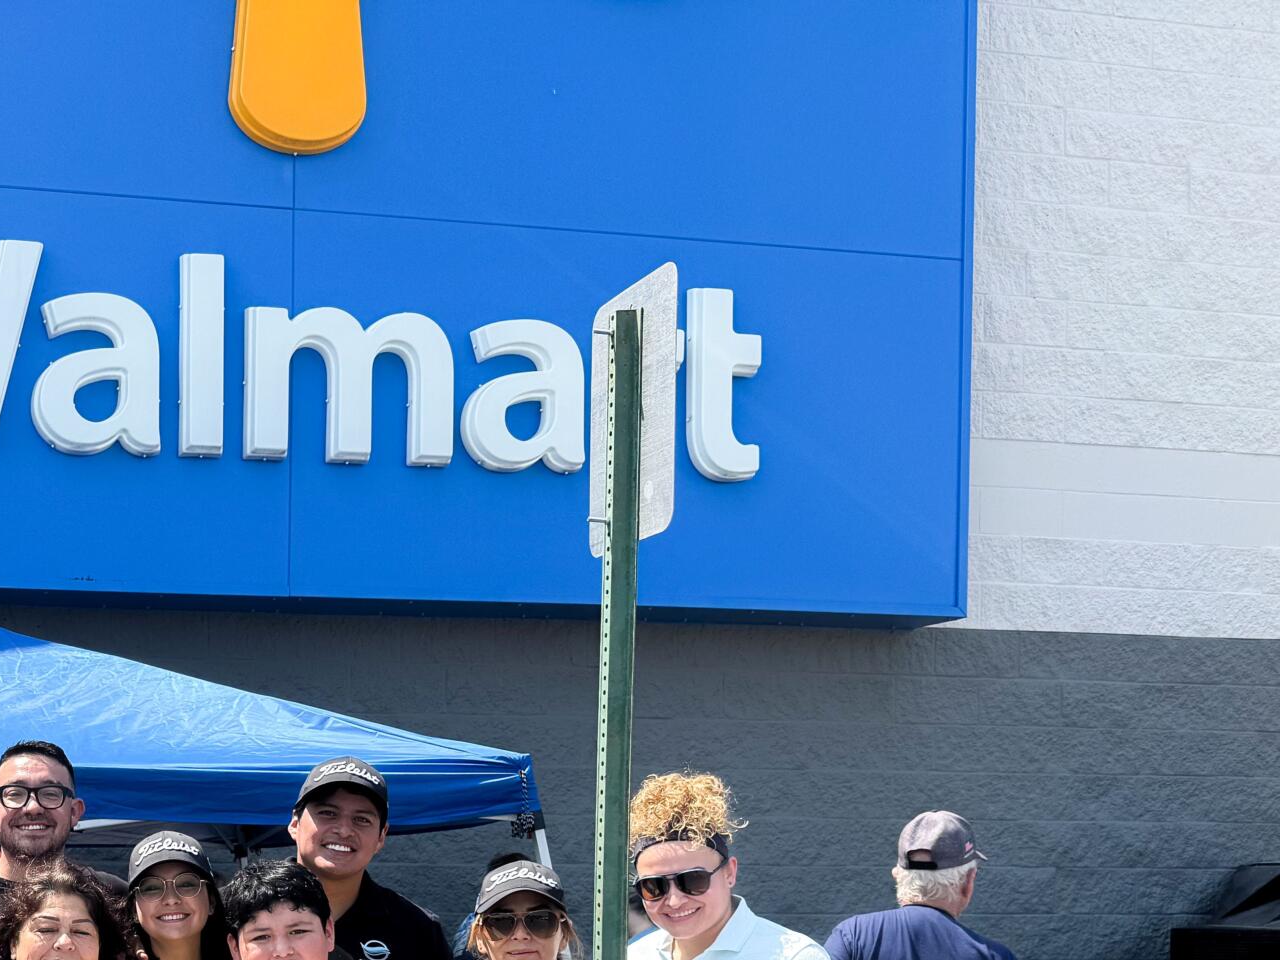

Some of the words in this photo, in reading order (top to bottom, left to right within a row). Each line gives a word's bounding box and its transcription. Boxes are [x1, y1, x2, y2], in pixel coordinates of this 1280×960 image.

[313, 761, 380, 785] Titleist
[134, 837, 200, 866] Titleist
[485, 866, 558, 892] Titleist
